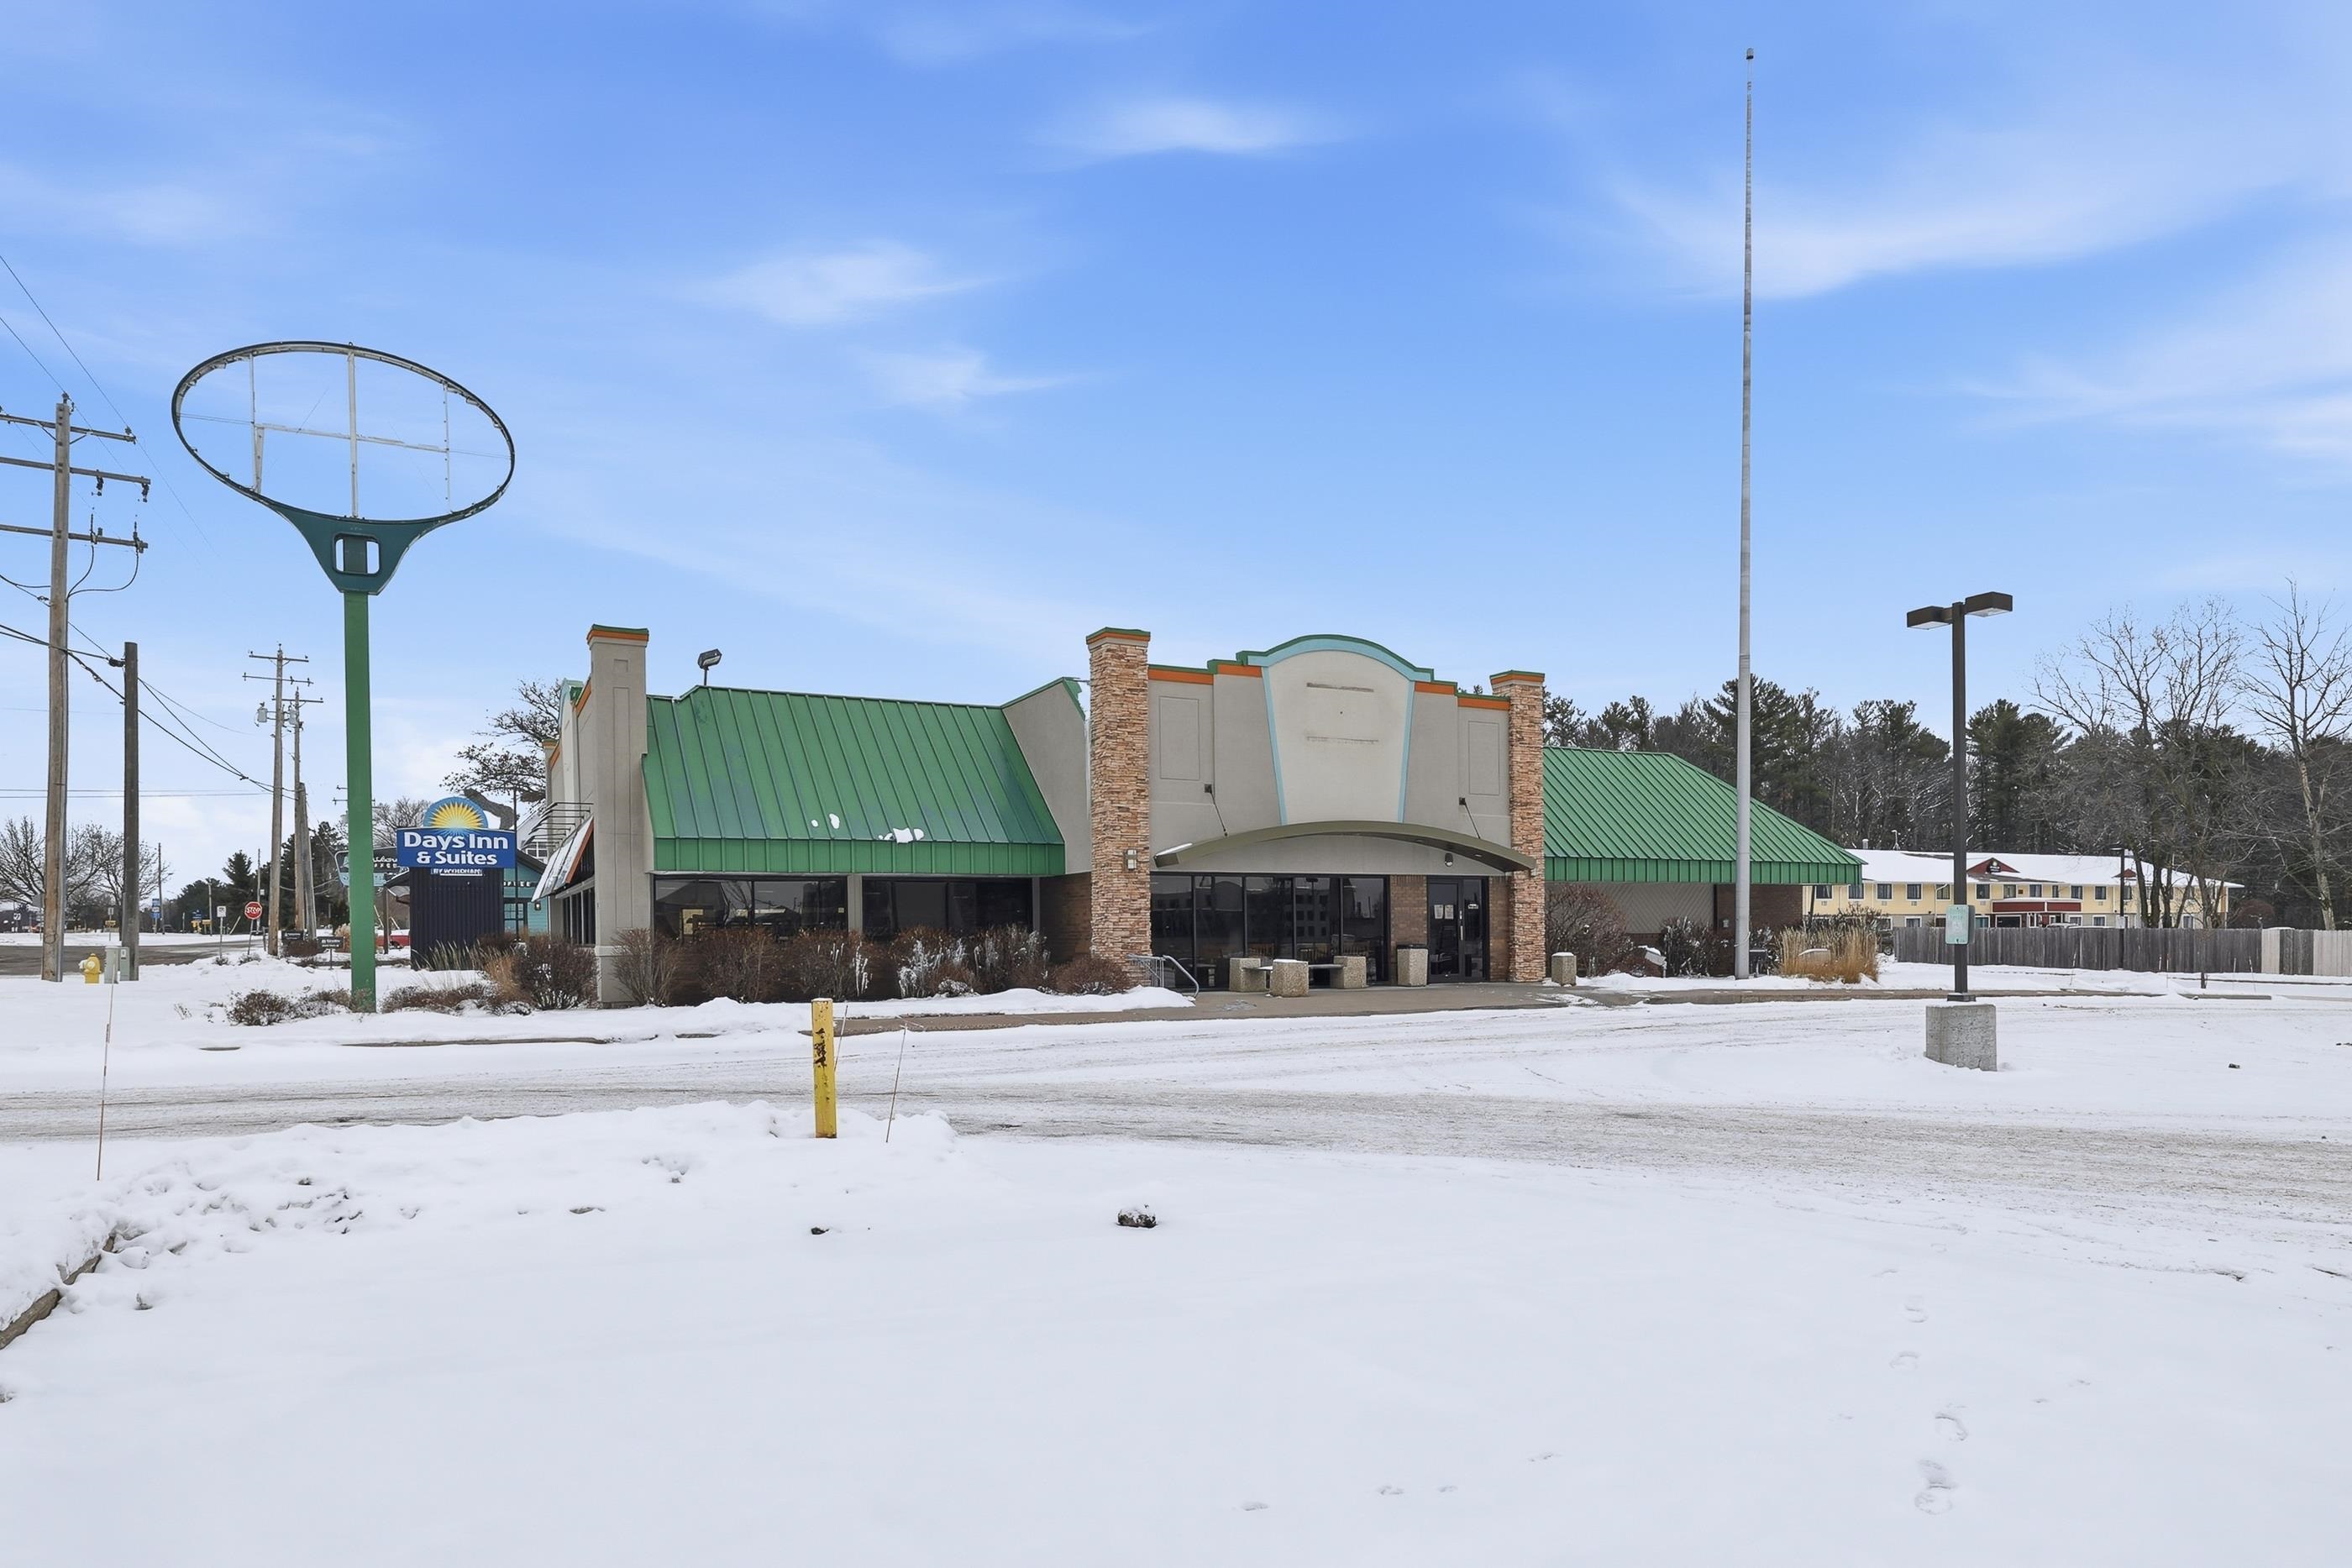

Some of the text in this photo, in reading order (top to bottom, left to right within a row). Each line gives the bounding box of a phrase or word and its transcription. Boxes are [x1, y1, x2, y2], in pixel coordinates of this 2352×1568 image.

[404, 831, 508, 850] Days Inn
[417, 851, 497, 865] & Suites
